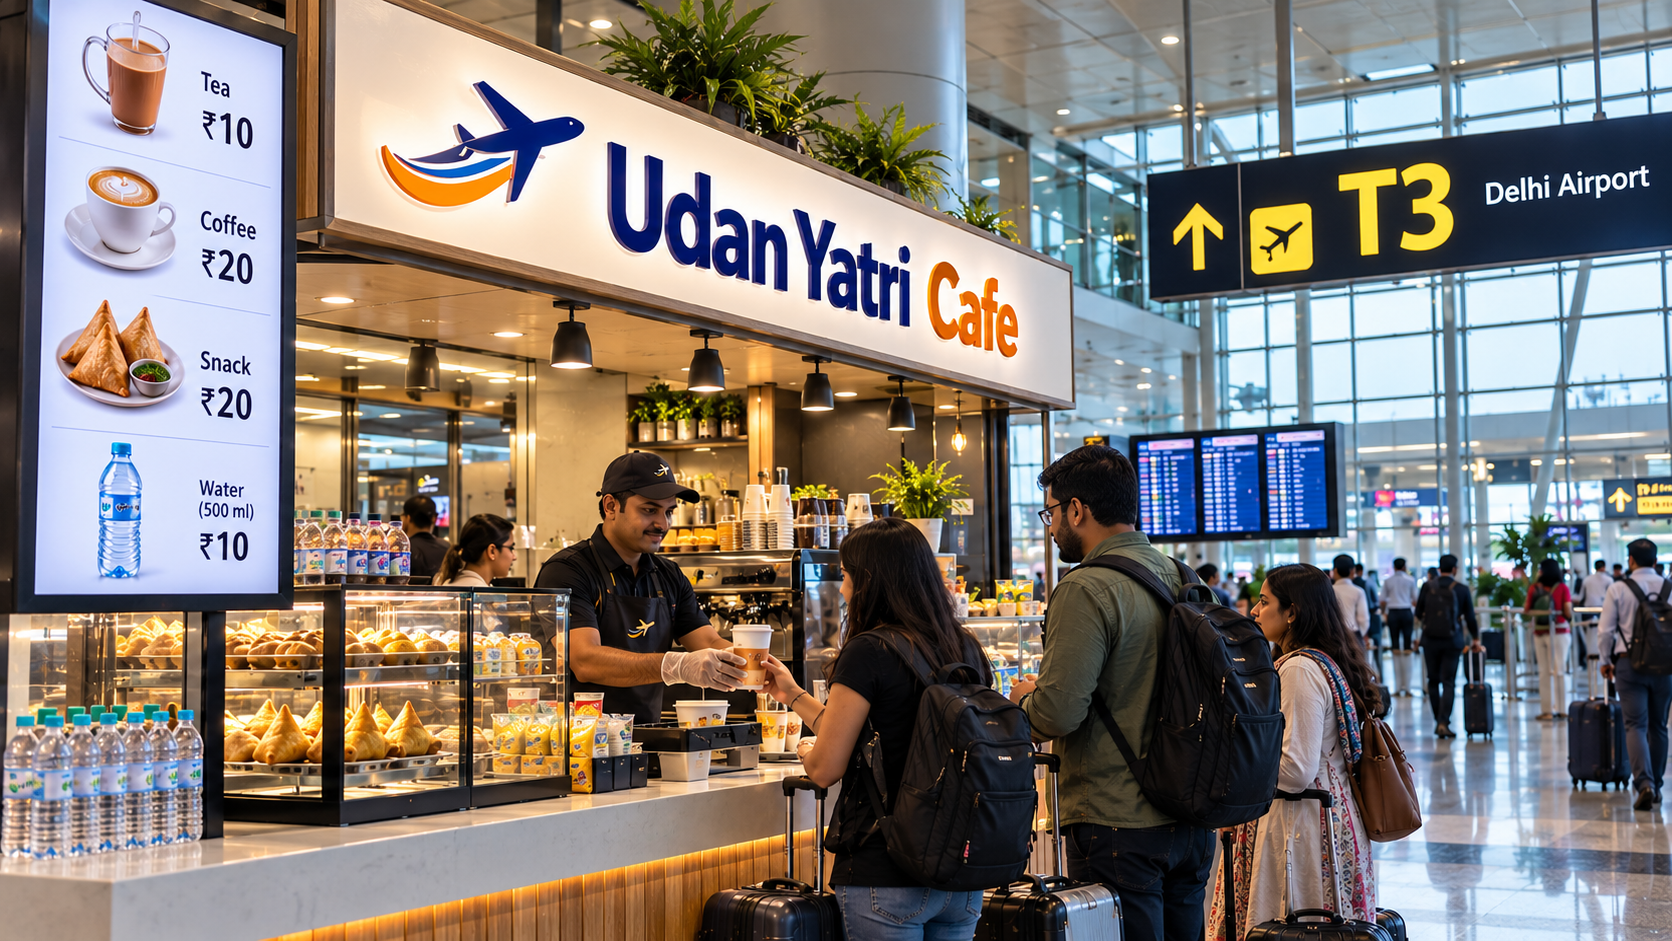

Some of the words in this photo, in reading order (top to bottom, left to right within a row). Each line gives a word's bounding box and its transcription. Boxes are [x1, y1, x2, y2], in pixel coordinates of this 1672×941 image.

[200, 71, 230, 99] Tea
[202, 110, 254, 150] ₹10
[200, 210, 257, 240] Coffee
[1338, 162, 1454, 257] T3
[1485, 174, 1550, 206] Delhi
[1557, 165, 1650, 199] Airport
[607, 141, 788, 292] Udan
[793, 209, 911, 327] Yatri
[927, 261, 1019, 358] Cafe
[201, 248, 254, 285] ₹20
[200, 350, 252, 376] Snack
[201, 386, 252, 421] ₹20
[199, 479, 245, 498] Water
[198, 500, 228, 521] (500
[232, 503, 254, 522] ml)
[199, 531, 249, 562] ₹10
